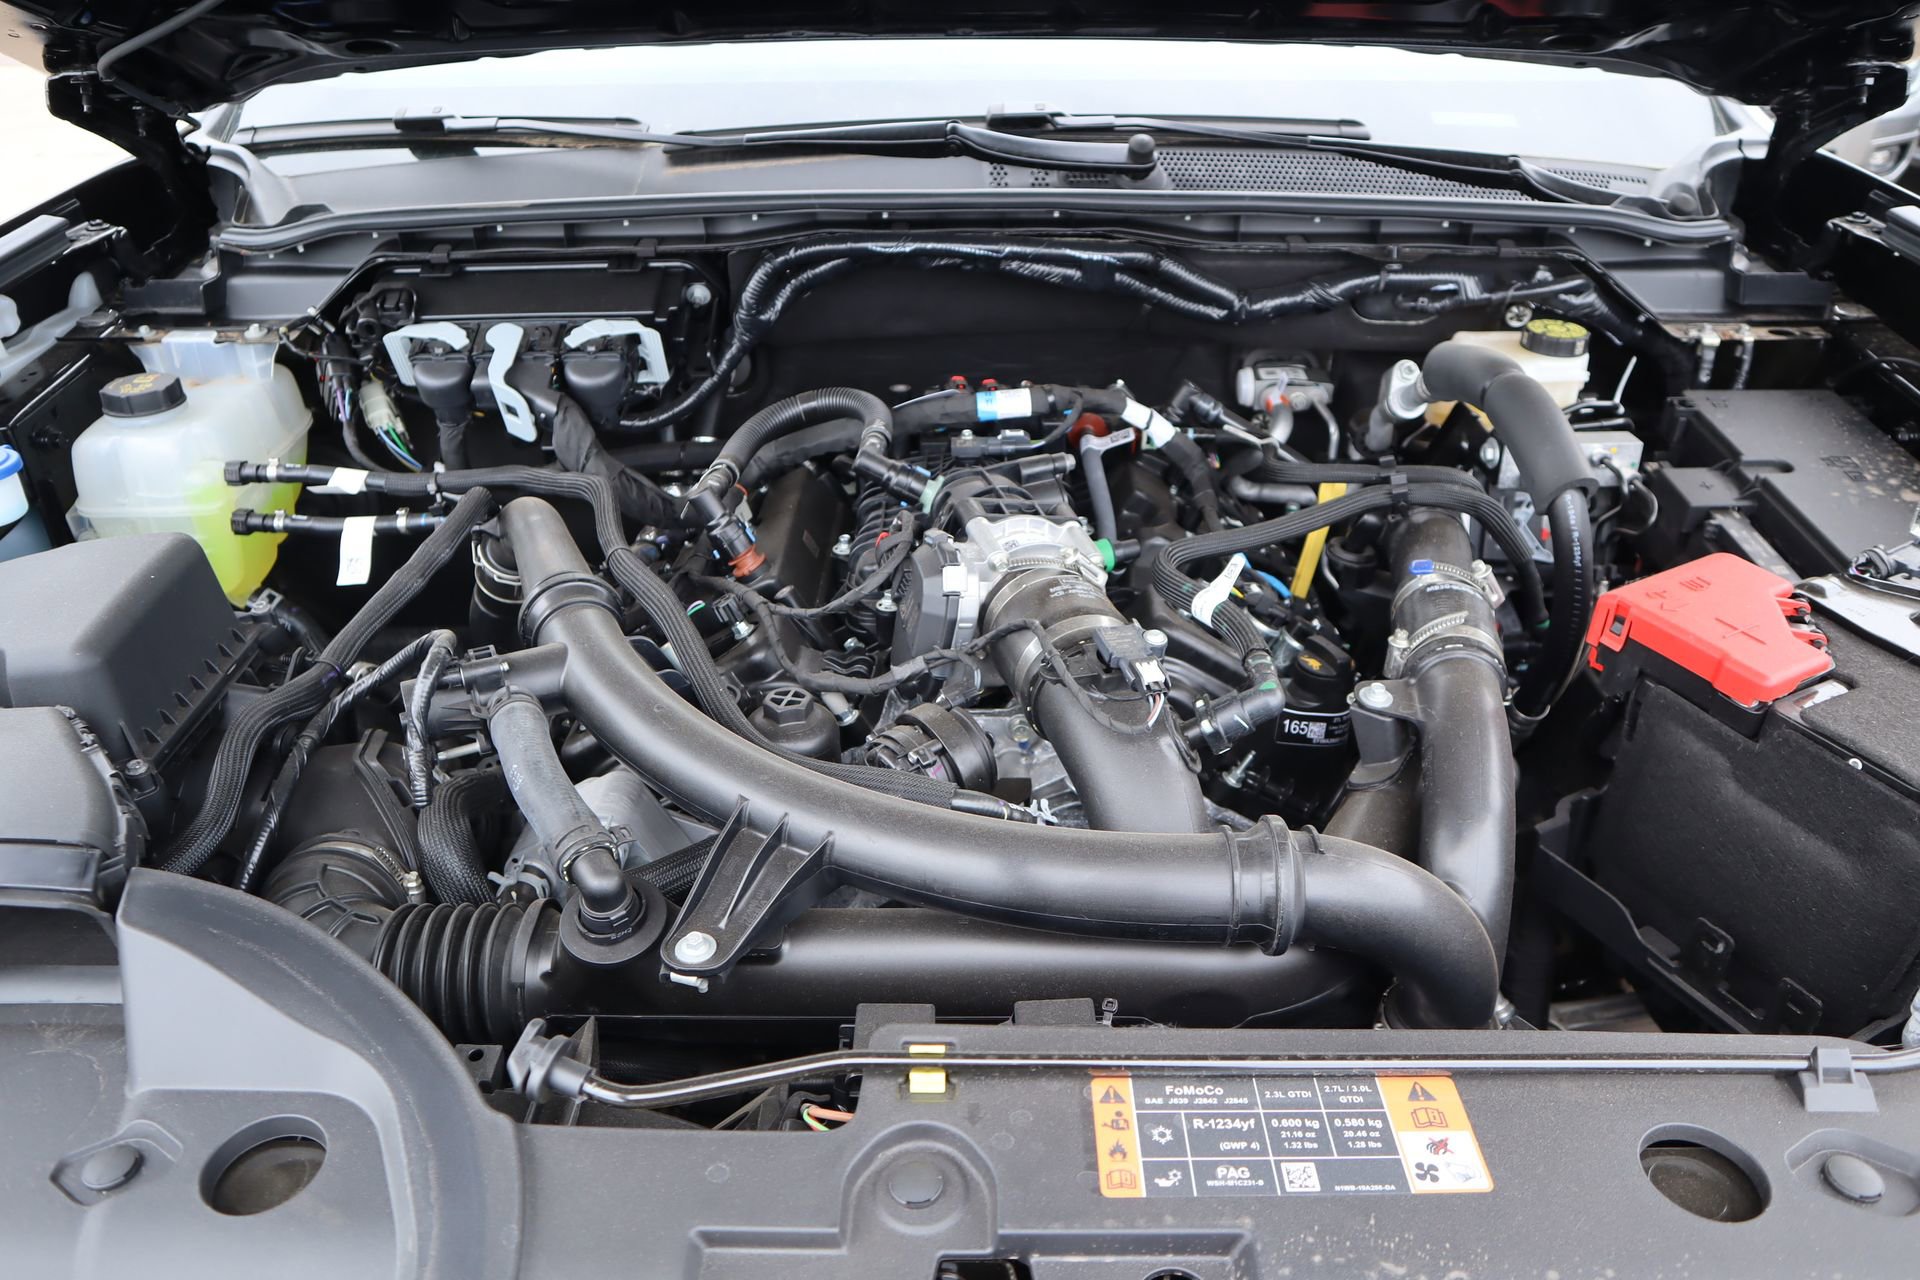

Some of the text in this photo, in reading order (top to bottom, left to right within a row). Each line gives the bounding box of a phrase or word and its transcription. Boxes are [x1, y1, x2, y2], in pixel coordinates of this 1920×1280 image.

[1282, 718, 1309, 735] 165
[1164, 1085, 1224, 1096] FoMoCo
[1264, 1090, 1312, 1099] 2.3L GTDI
[1323, 1085, 1345, 1093] 2.7L
[1351, 1085, 1373, 1093] 3.0L
[1338, 1095, 1364, 1104] GTDI
[1192, 1117, 1256, 1132] R-1234yf
[1270, 1118, 1320, 1130] 0.600 kg
[1333, 1117, 1383, 1129] 0.580 kg
[1219, 1141, 1261, 1152] (GWP 4)
[1283, 1141, 1319, 1149] 1.32 lbs
[1347, 1140, 1383, 1149] 1.28 lbs
[1215, 1165, 1251, 1179] PAG
